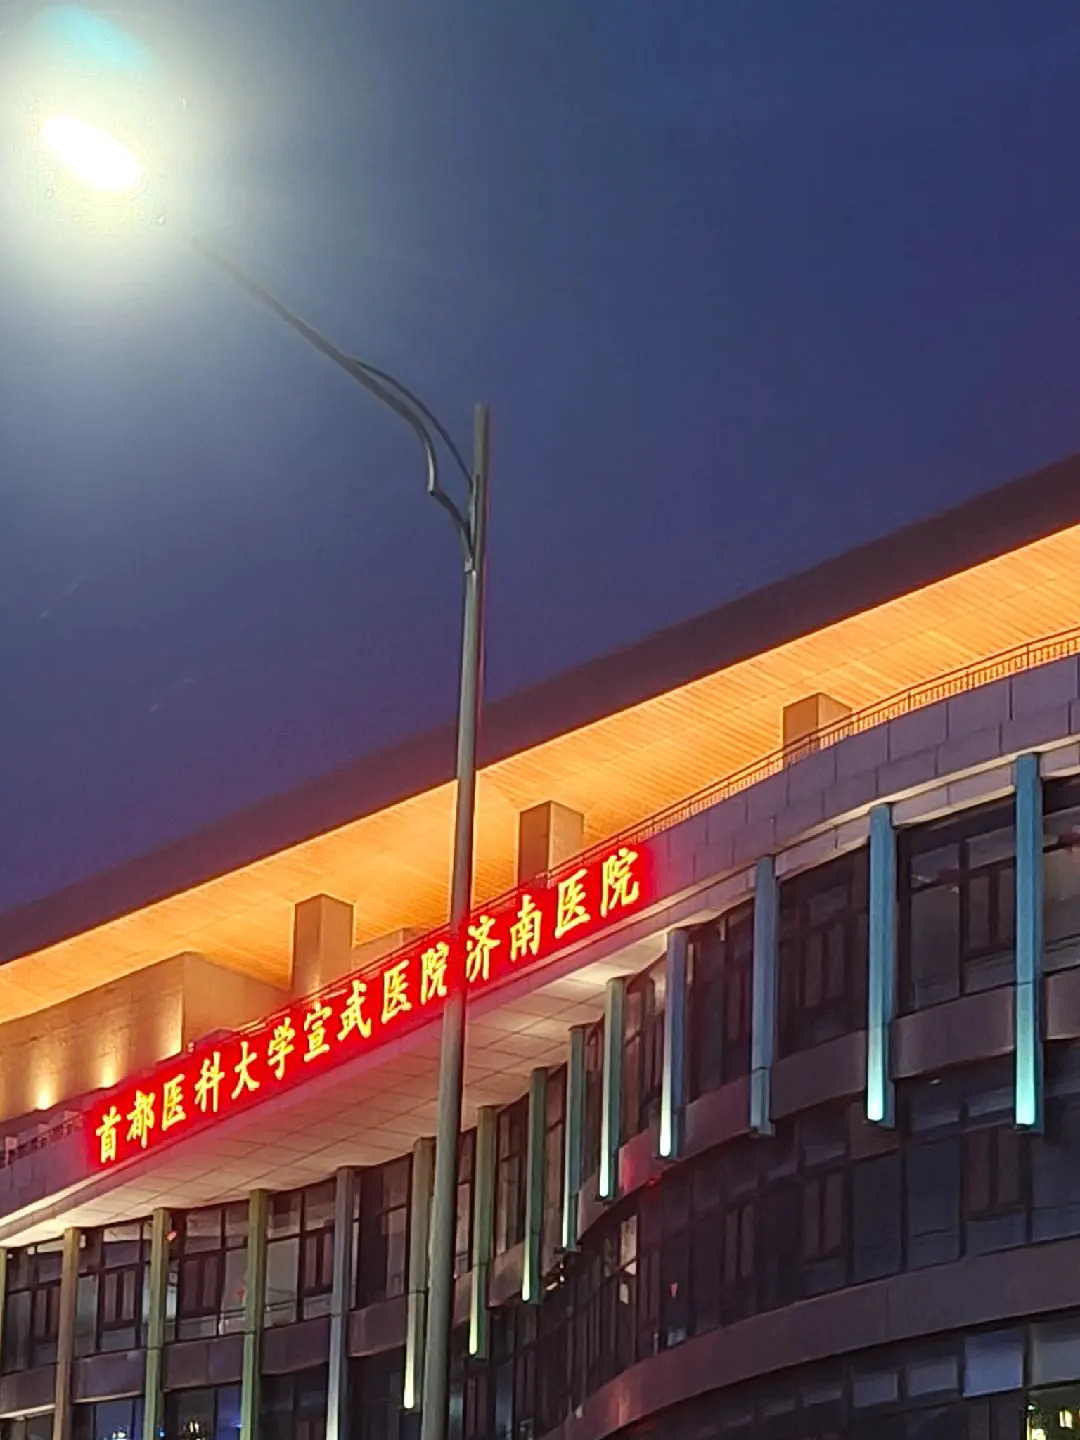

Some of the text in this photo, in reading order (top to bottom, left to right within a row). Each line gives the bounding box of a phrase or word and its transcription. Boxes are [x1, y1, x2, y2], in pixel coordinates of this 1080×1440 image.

[96, 848, 639, 1163] 首都医科大学宣武医院济南医院
